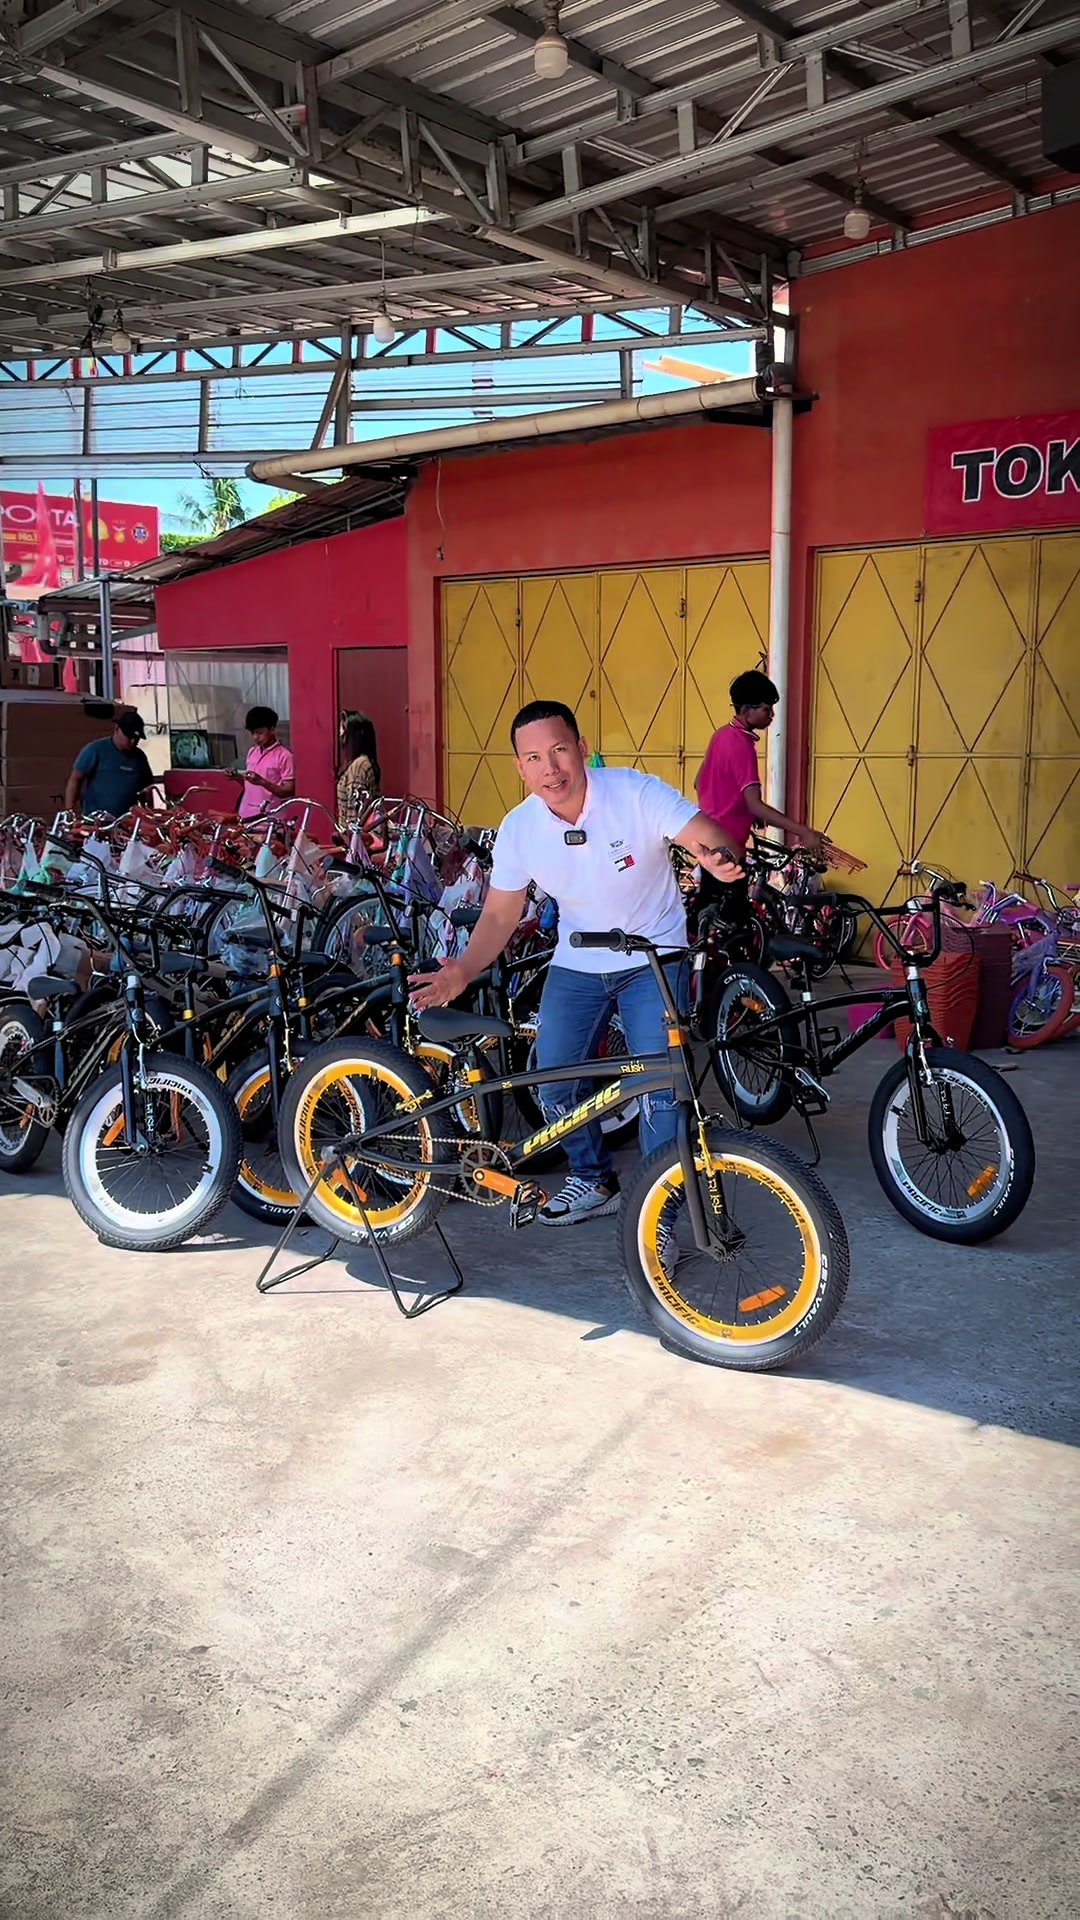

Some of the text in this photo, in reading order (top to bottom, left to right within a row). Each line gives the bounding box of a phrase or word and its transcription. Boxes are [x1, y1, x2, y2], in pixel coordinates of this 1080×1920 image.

[620, 1063, 645, 1074] RUSH
[523, 1080, 621, 1156] PACIFIC
[901, 1179, 942, 1216] PACIFIC
[653, 1275, 702, 1327] PACIFIC
[794, 1297, 823, 1337] VAULT
